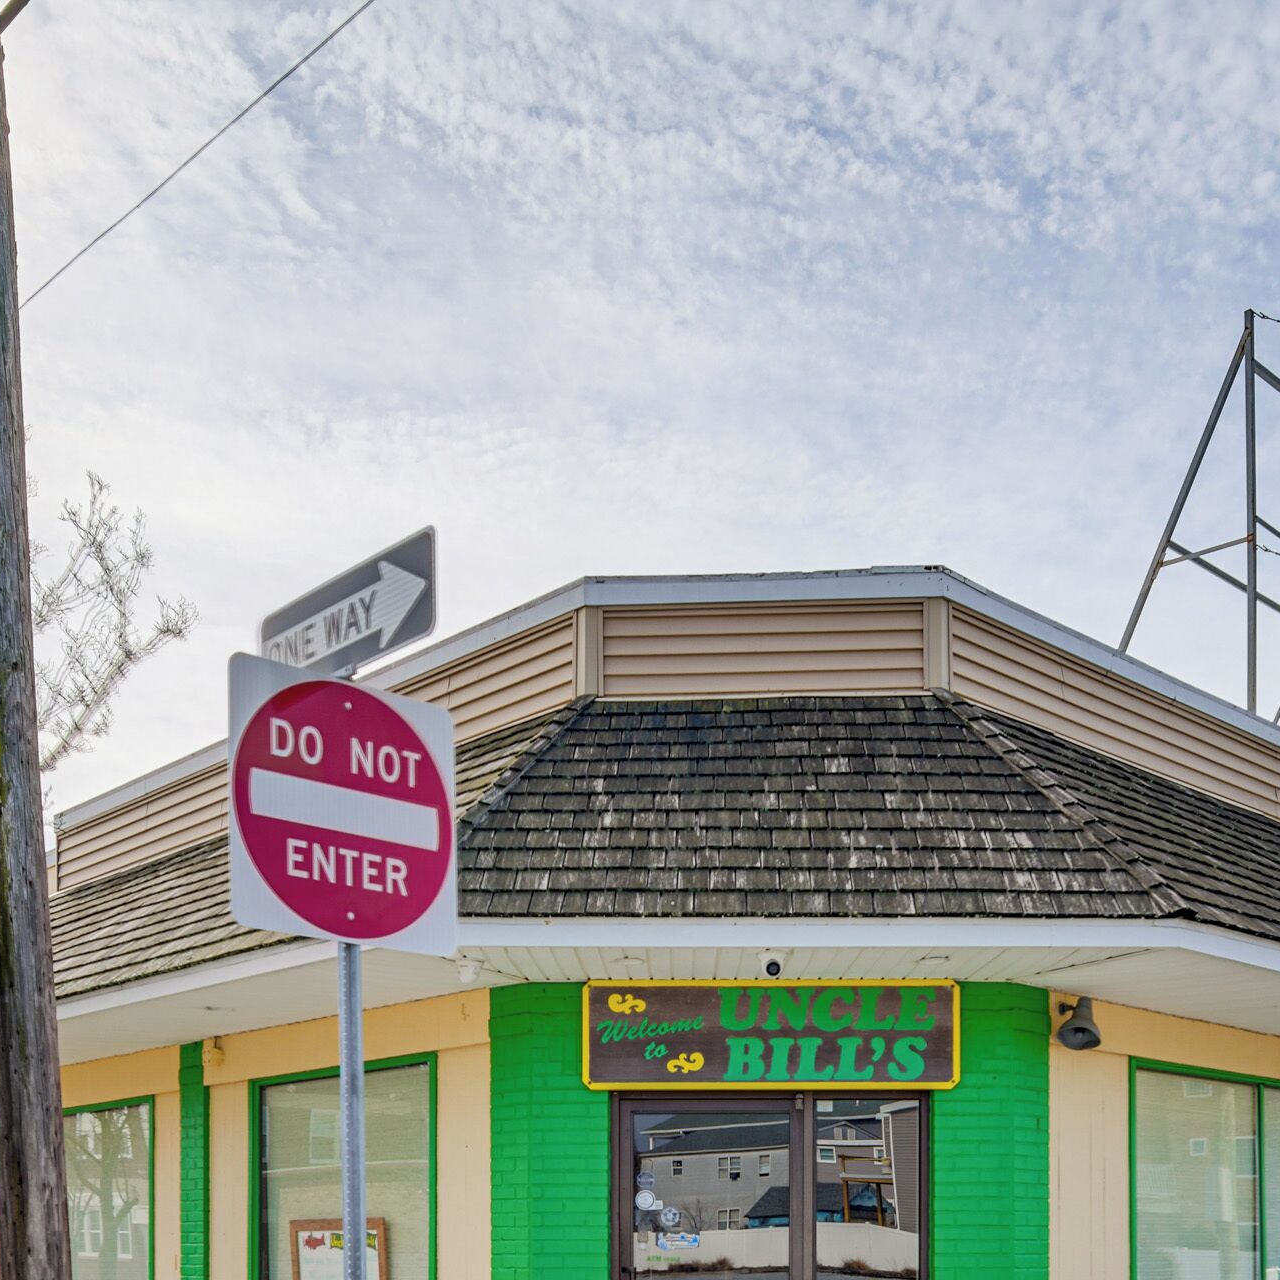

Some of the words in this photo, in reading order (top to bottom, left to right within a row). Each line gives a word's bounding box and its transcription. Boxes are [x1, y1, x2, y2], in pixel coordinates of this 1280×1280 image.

[323, 589, 378, 649] WAY
[269, 717, 322, 765] DO
[349, 736, 422, 788] NOT
[286, 837, 409, 897] ENTER
[596, 1014, 705, 1044] Welcome
[717, 986, 937, 1032] UNCLE
[643, 1041, 669, 1060] to
[722, 1035, 928, 1082] BILL'S
